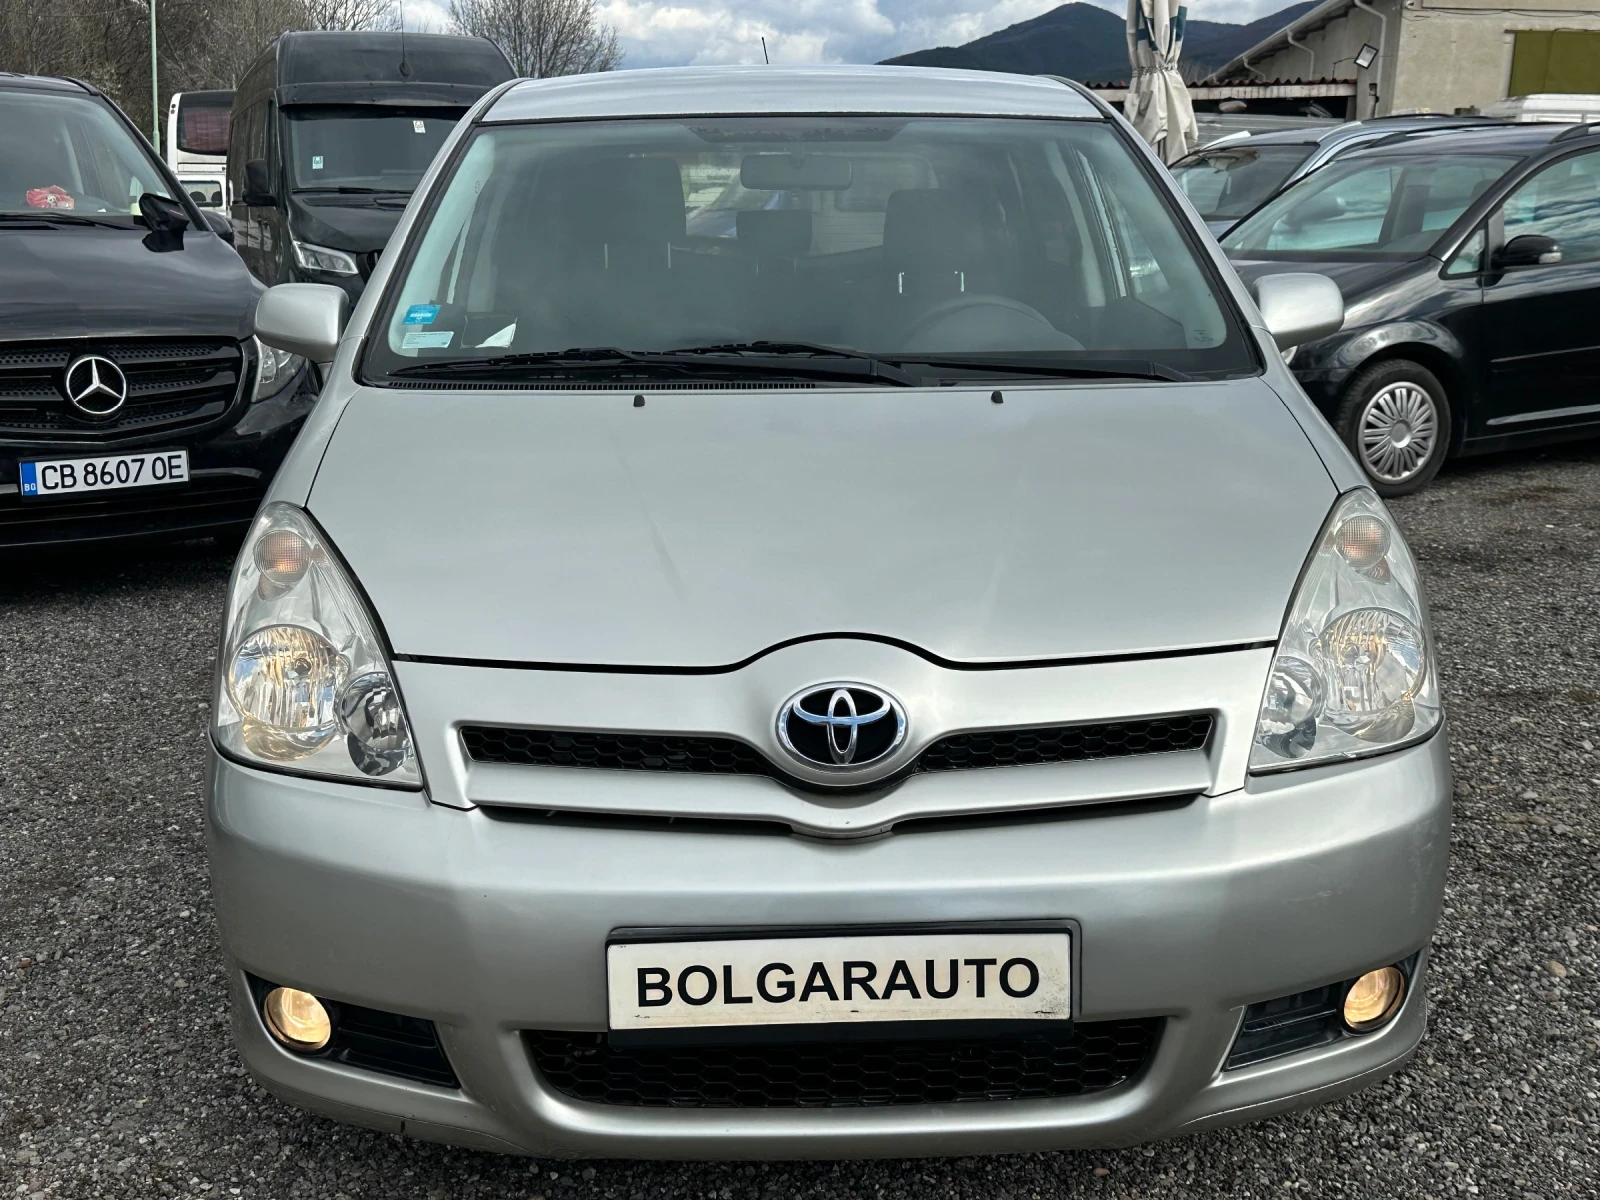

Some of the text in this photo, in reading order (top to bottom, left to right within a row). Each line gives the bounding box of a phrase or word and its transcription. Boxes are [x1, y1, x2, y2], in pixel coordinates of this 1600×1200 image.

[24, 483, 36, 491] BG
[41, 463, 77, 490] CB
[83, 458, 145, 487] 8607
[636, 957, 1040, 1008] BOLGARAUTO
